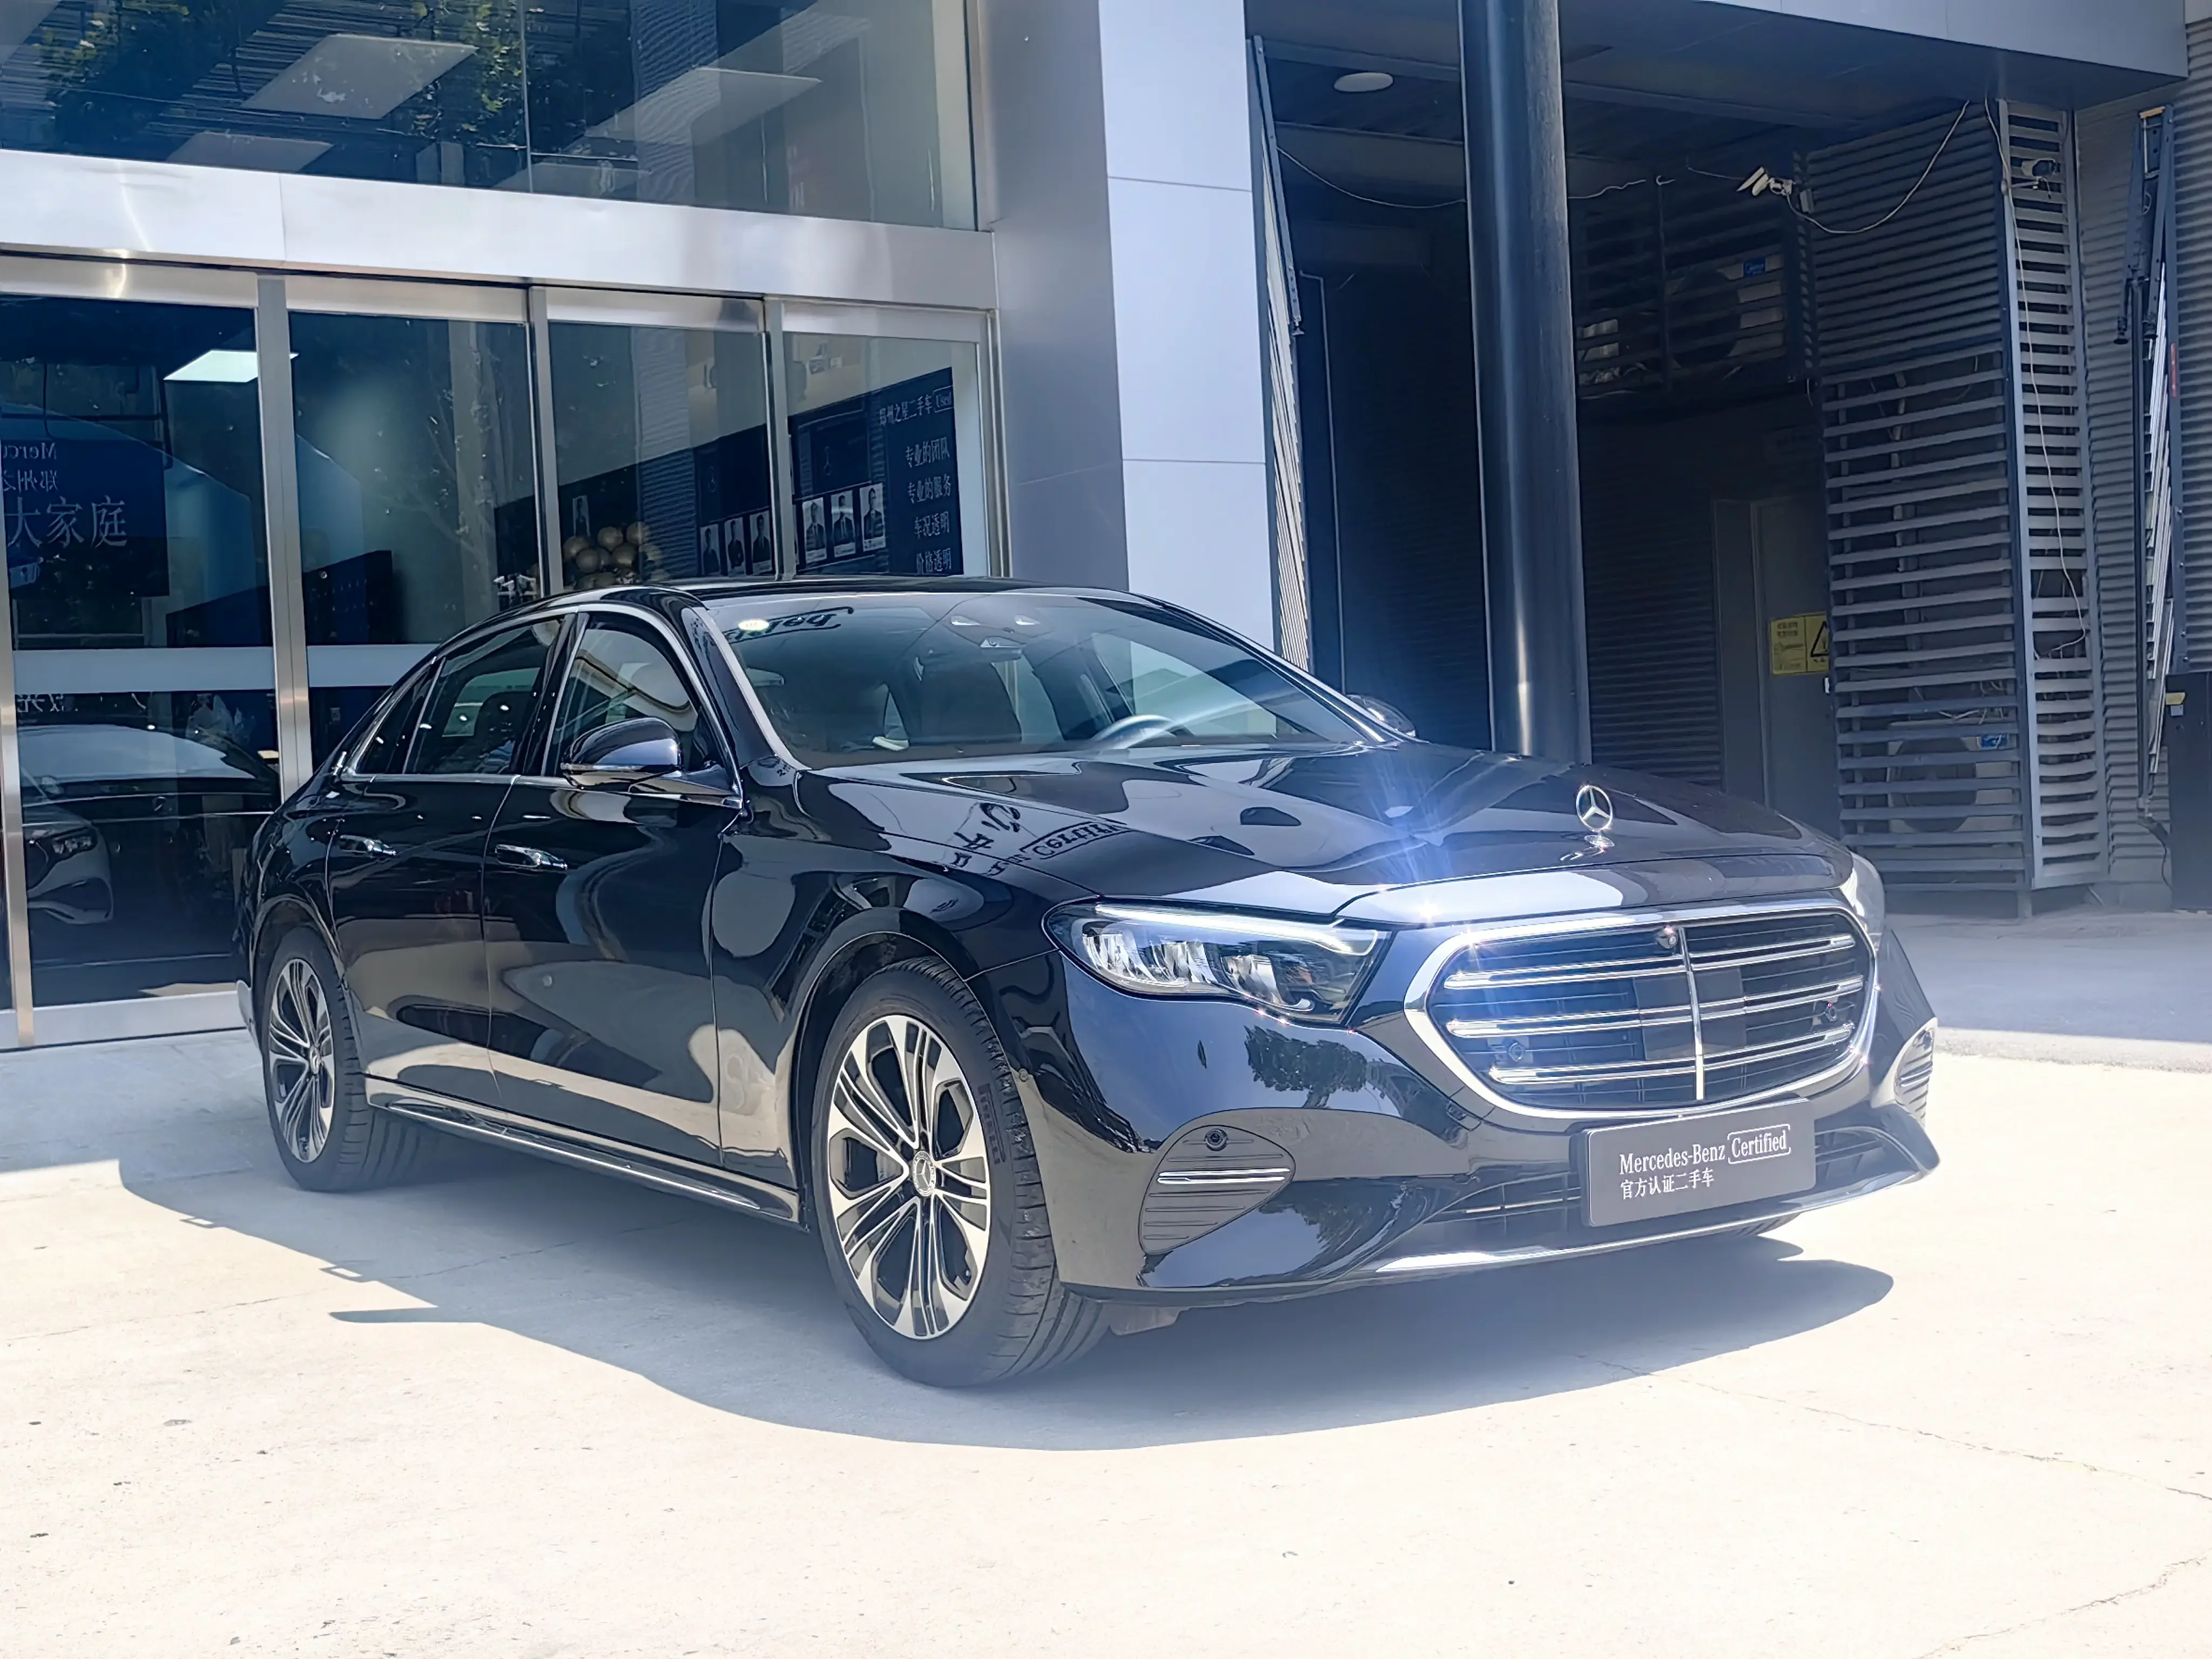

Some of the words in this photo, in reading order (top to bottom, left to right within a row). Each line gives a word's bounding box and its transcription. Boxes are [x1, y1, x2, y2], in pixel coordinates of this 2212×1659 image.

[5, 495, 127, 548] 大家庭
[1620, 1144, 1725, 1175] Mercedes-Benz
[1731, 1130, 1787, 1158] Certified
[1620, 1166, 1715, 1201] 官方认证二手车
